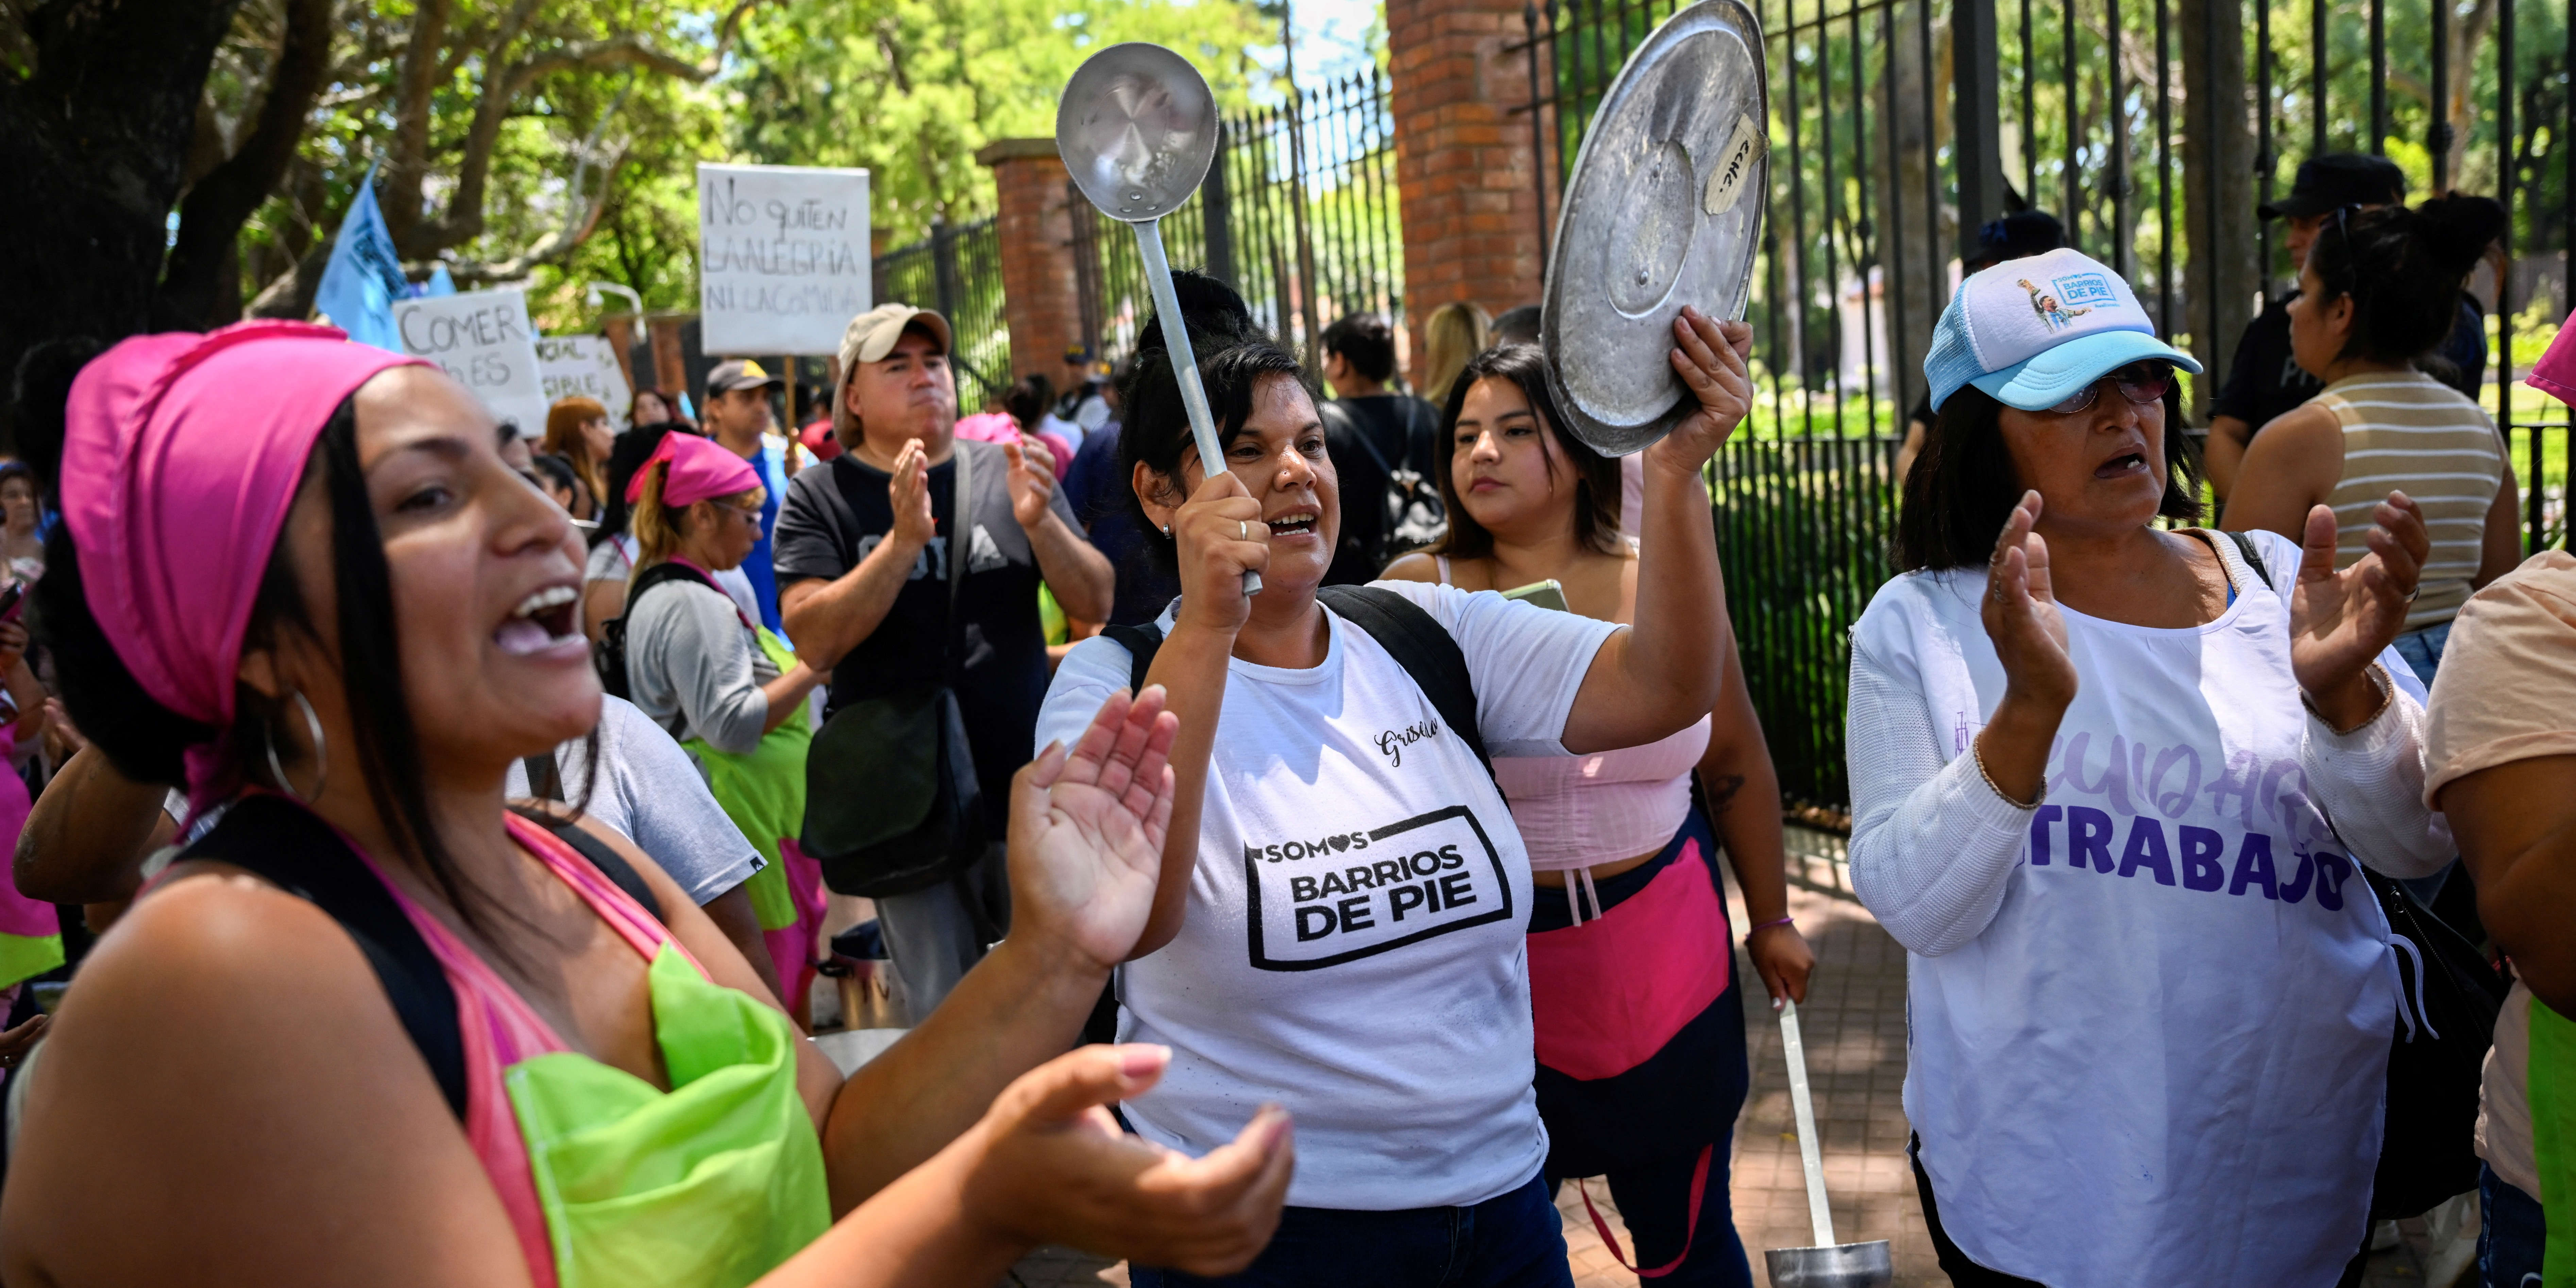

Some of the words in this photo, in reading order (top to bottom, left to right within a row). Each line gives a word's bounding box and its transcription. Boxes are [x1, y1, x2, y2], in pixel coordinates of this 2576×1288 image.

[707, 284, 735, 311] NI
[2063, 279, 2103, 290] BARRIOS
[2067, 288, 2088, 299] DE
[2088, 287, 2108, 296] PIE
[399, 304, 530, 355] COMER
[471, 351, 511, 387] ES
[1290, 844, 1464, 902] BARRIOS
[2030, 804, 2352, 911] TRABAJO
[1295, 895, 1375, 942] DE
[1388, 870, 1477, 922] PIE
